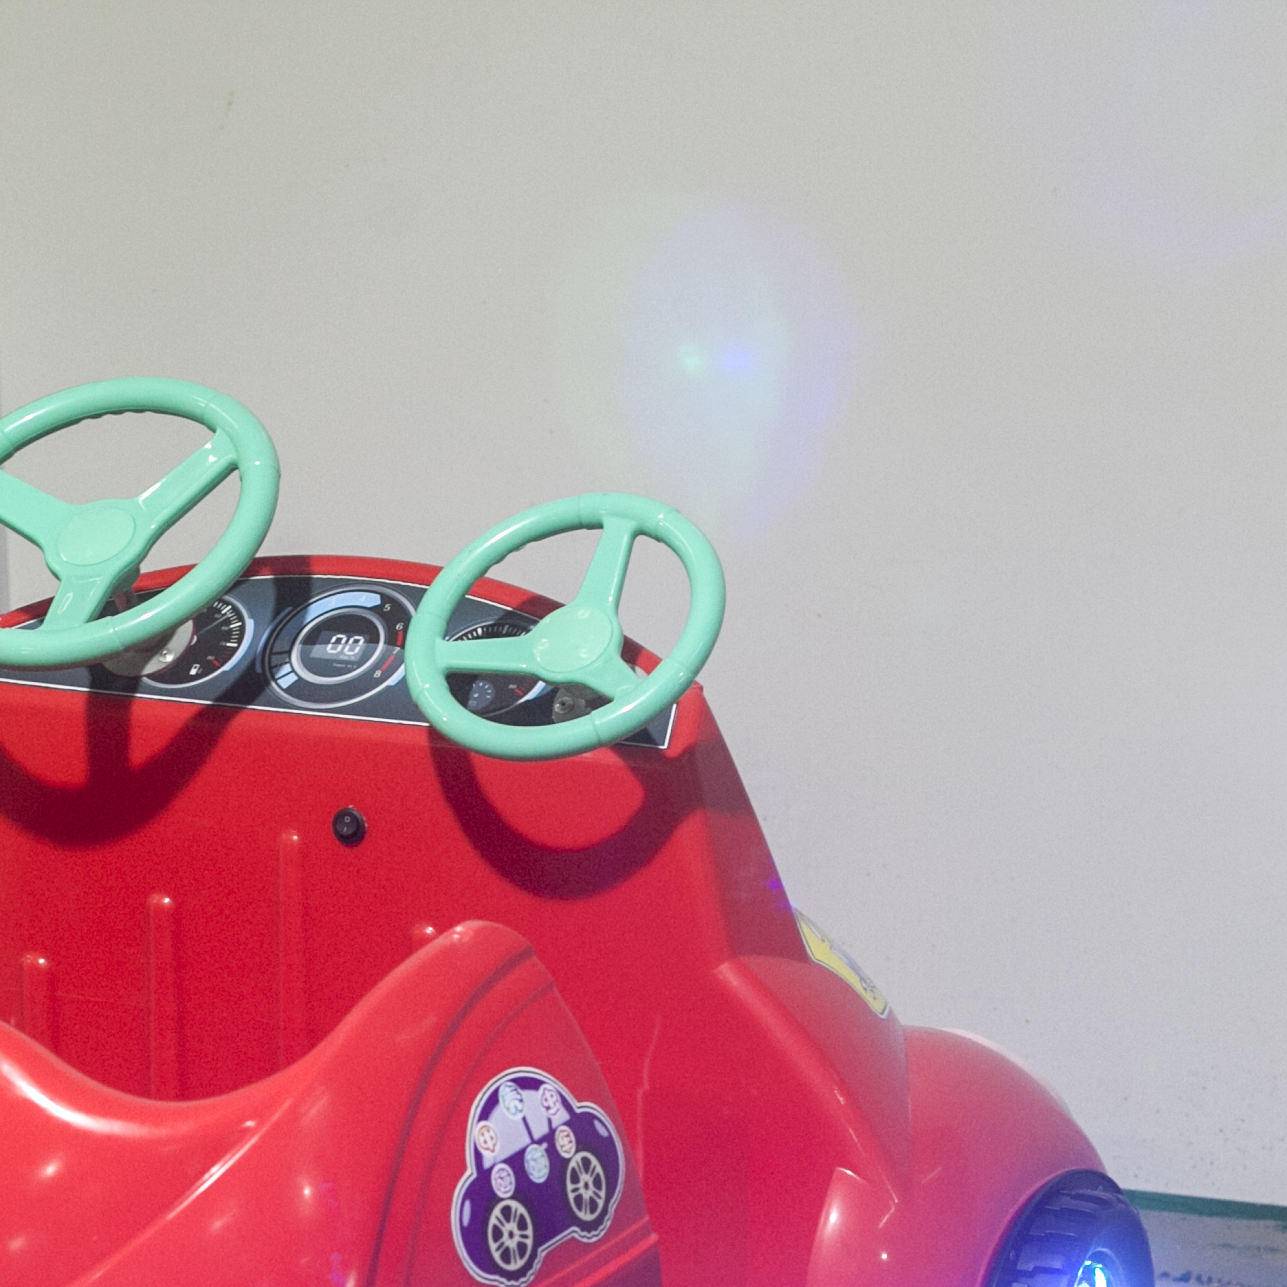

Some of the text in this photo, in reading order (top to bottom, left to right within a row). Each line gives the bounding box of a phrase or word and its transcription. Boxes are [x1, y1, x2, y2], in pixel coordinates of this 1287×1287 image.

[383, 603, 391, 612] 5
[395, 622, 404, 631] 6
[326, 634, 365, 655] 00
[392, 646, 401, 655] 7
[374, 670, 382, 678] 8
